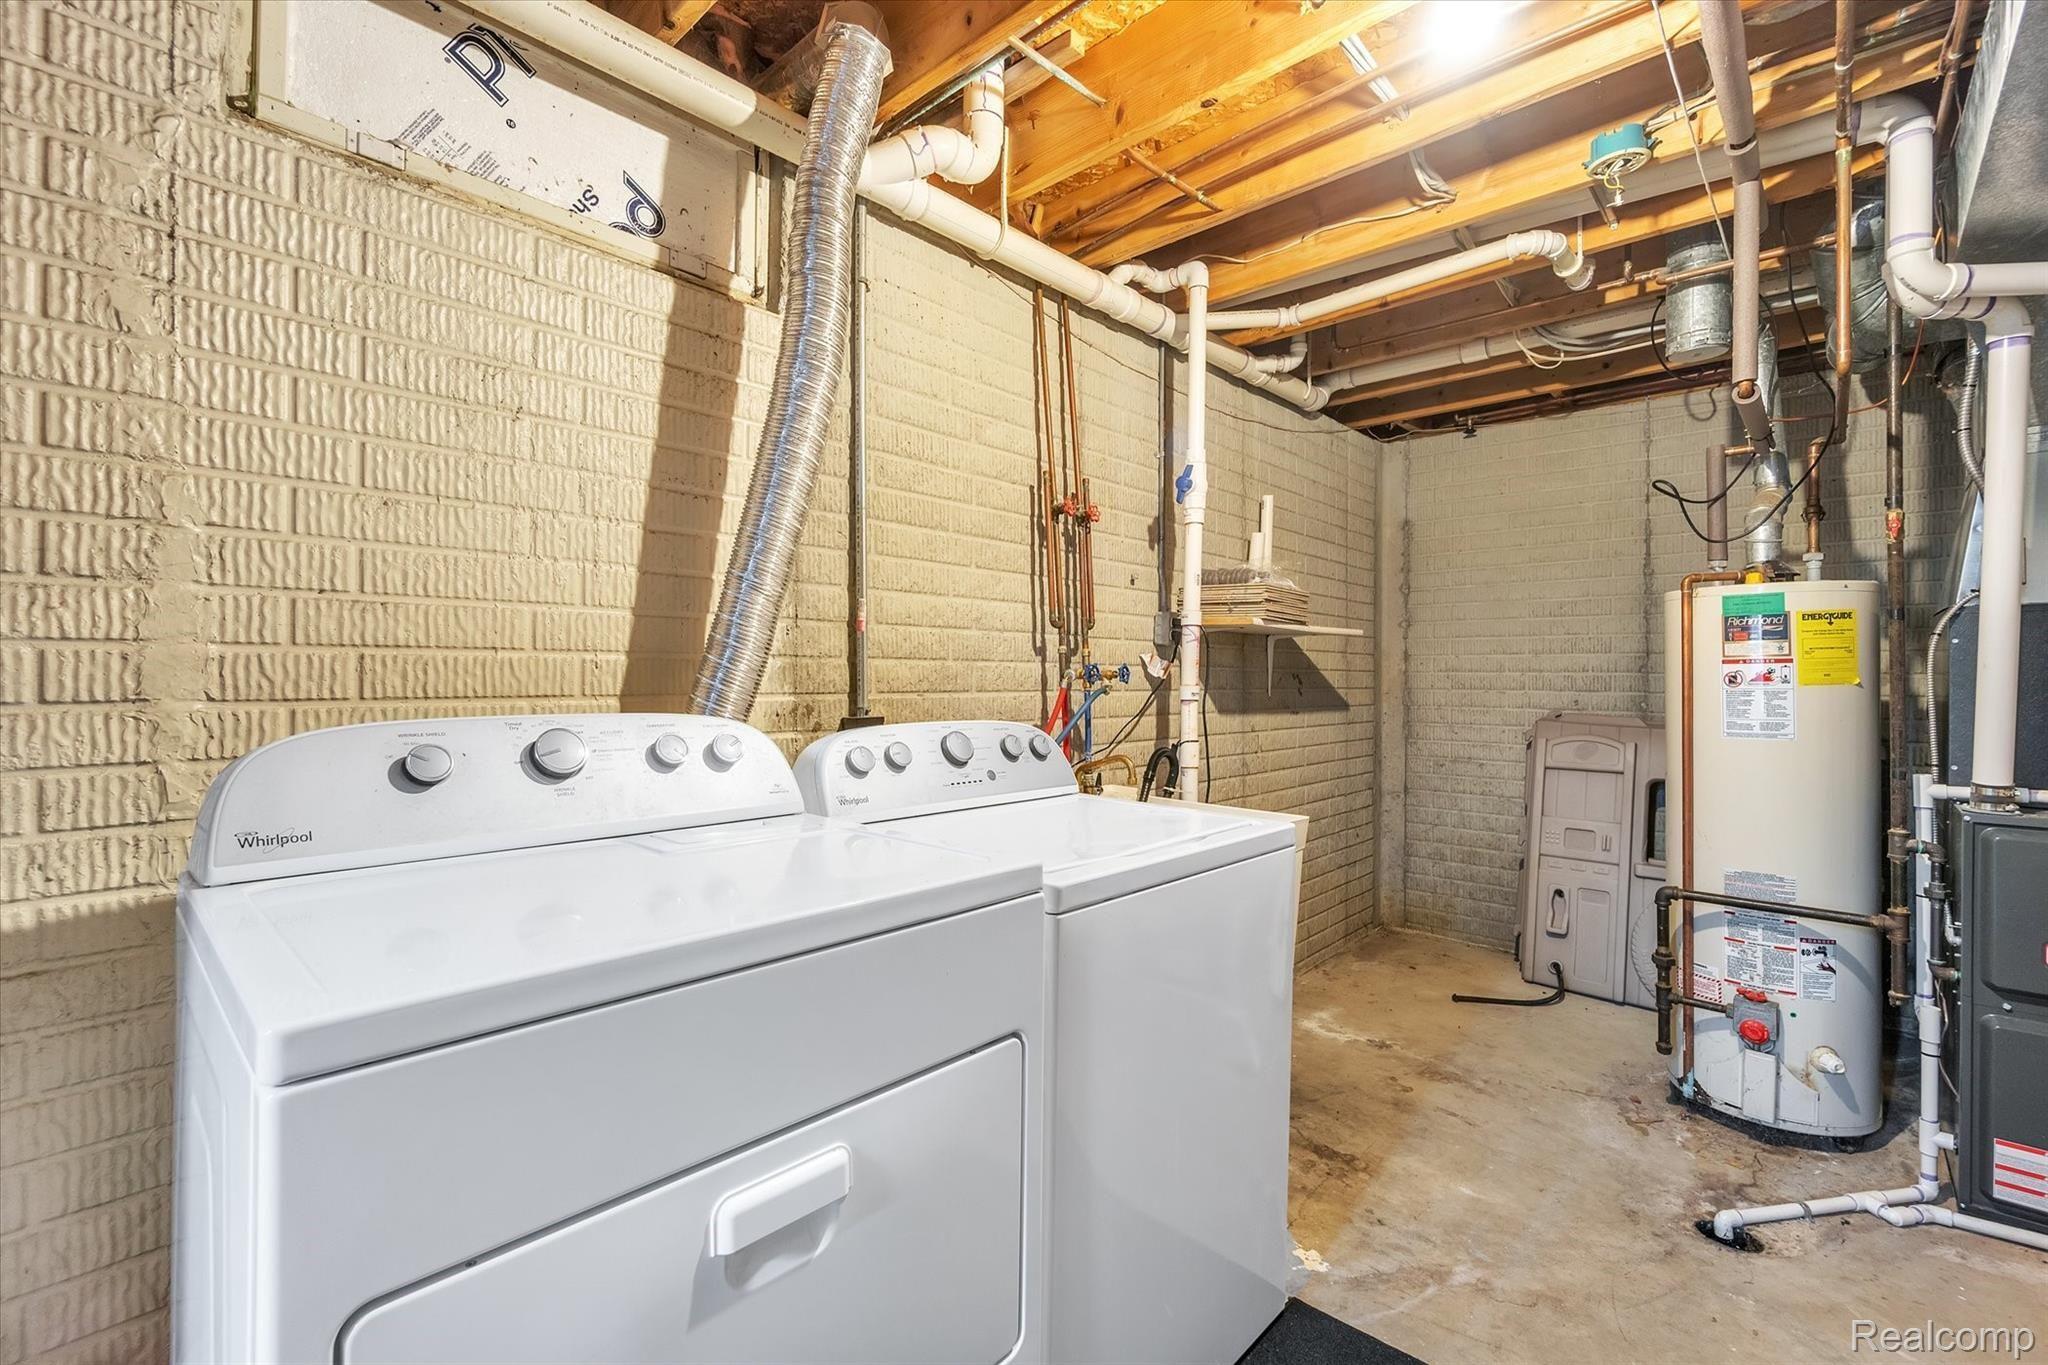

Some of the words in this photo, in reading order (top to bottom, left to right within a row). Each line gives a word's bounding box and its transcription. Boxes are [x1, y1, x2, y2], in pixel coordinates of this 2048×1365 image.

[1727, 614, 1785, 626] Richmond
[1802, 612, 1853, 622] ENERGYGUIDE
[837, 796, 870, 807] Whirlpool
[236, 829, 313, 849] Whirlpool
